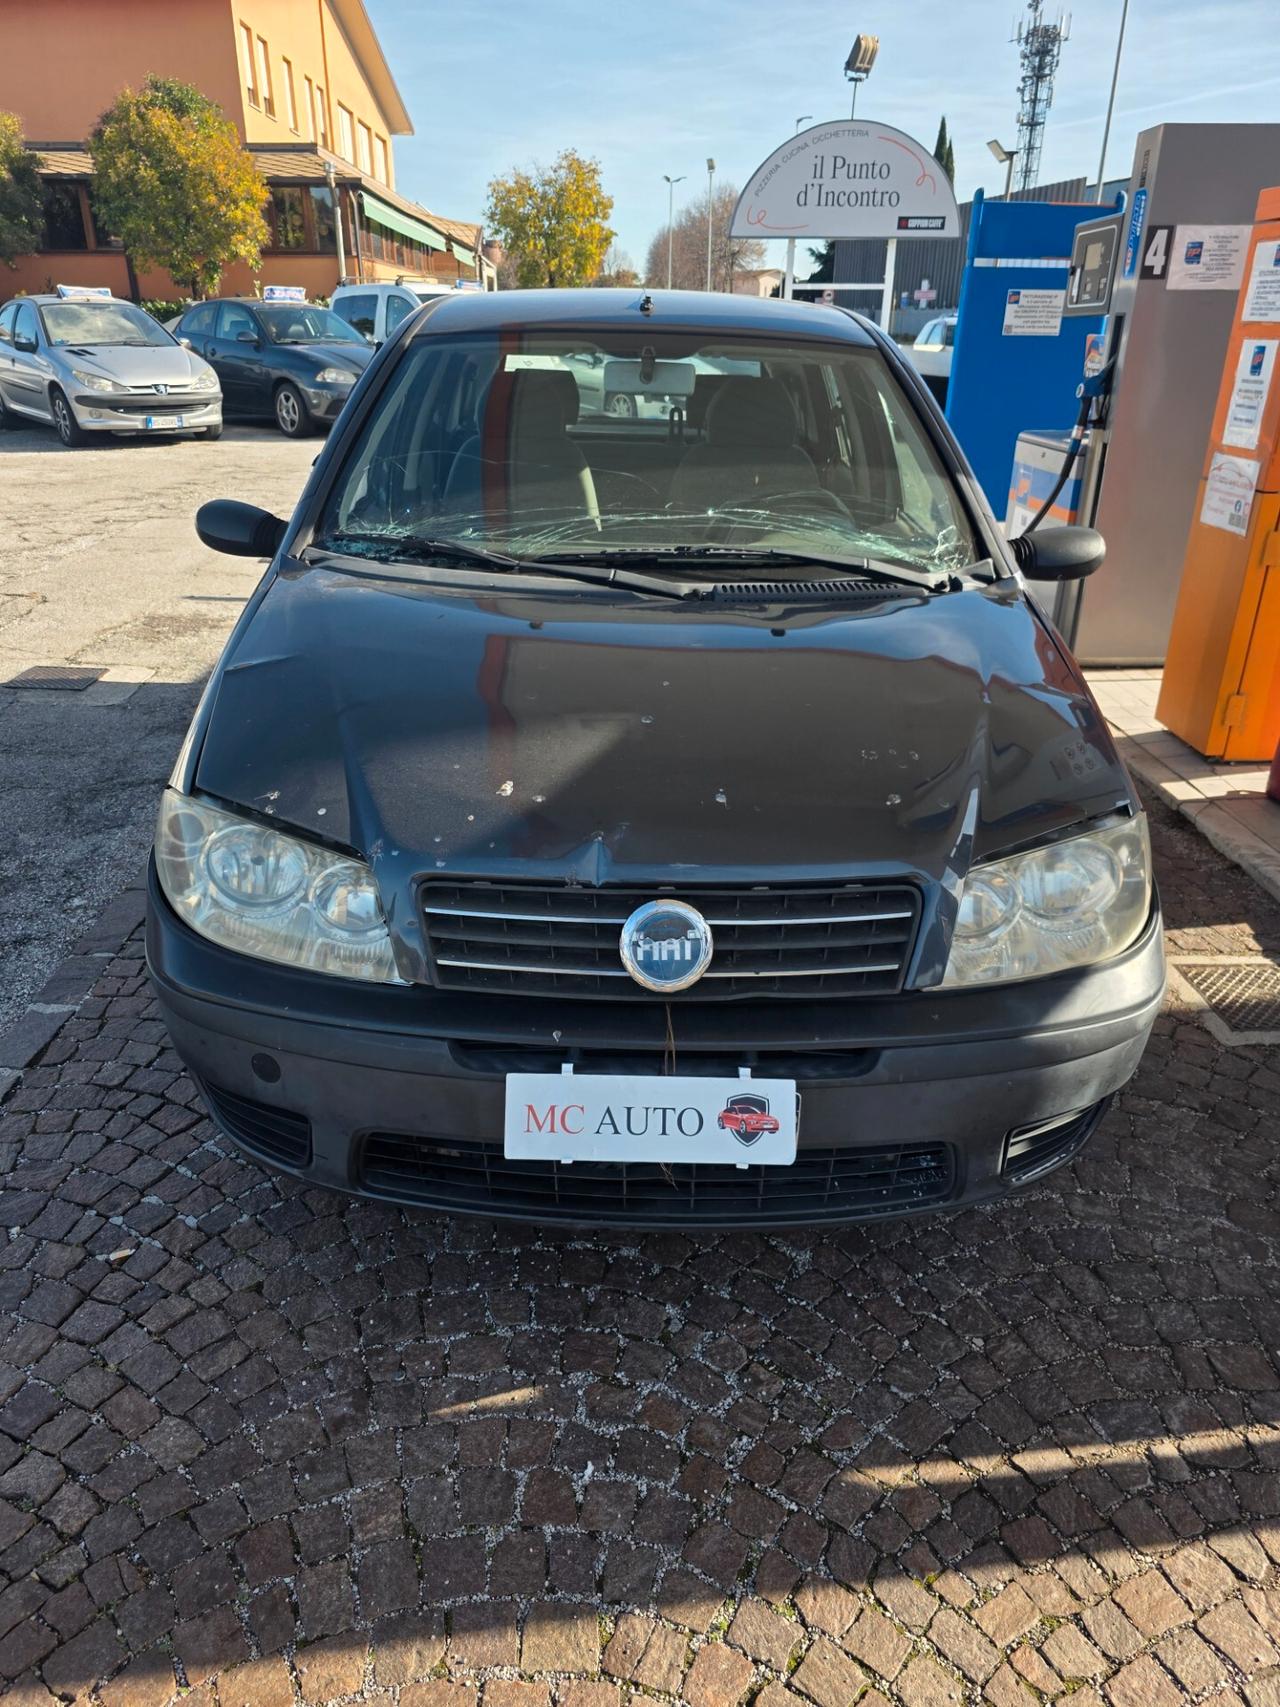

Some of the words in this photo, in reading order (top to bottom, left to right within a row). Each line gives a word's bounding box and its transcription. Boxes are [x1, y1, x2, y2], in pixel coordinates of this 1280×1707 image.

[782, 142, 809, 164] CUCINA
[812, 155, 825, 180] il
[831, 155, 891, 180] Punto
[796, 183, 901, 208] d'Incontro
[1144, 229, 1169, 275] 4
[523, 1104, 585, 1134] MC
[593, 1105, 704, 1137] AUTO
